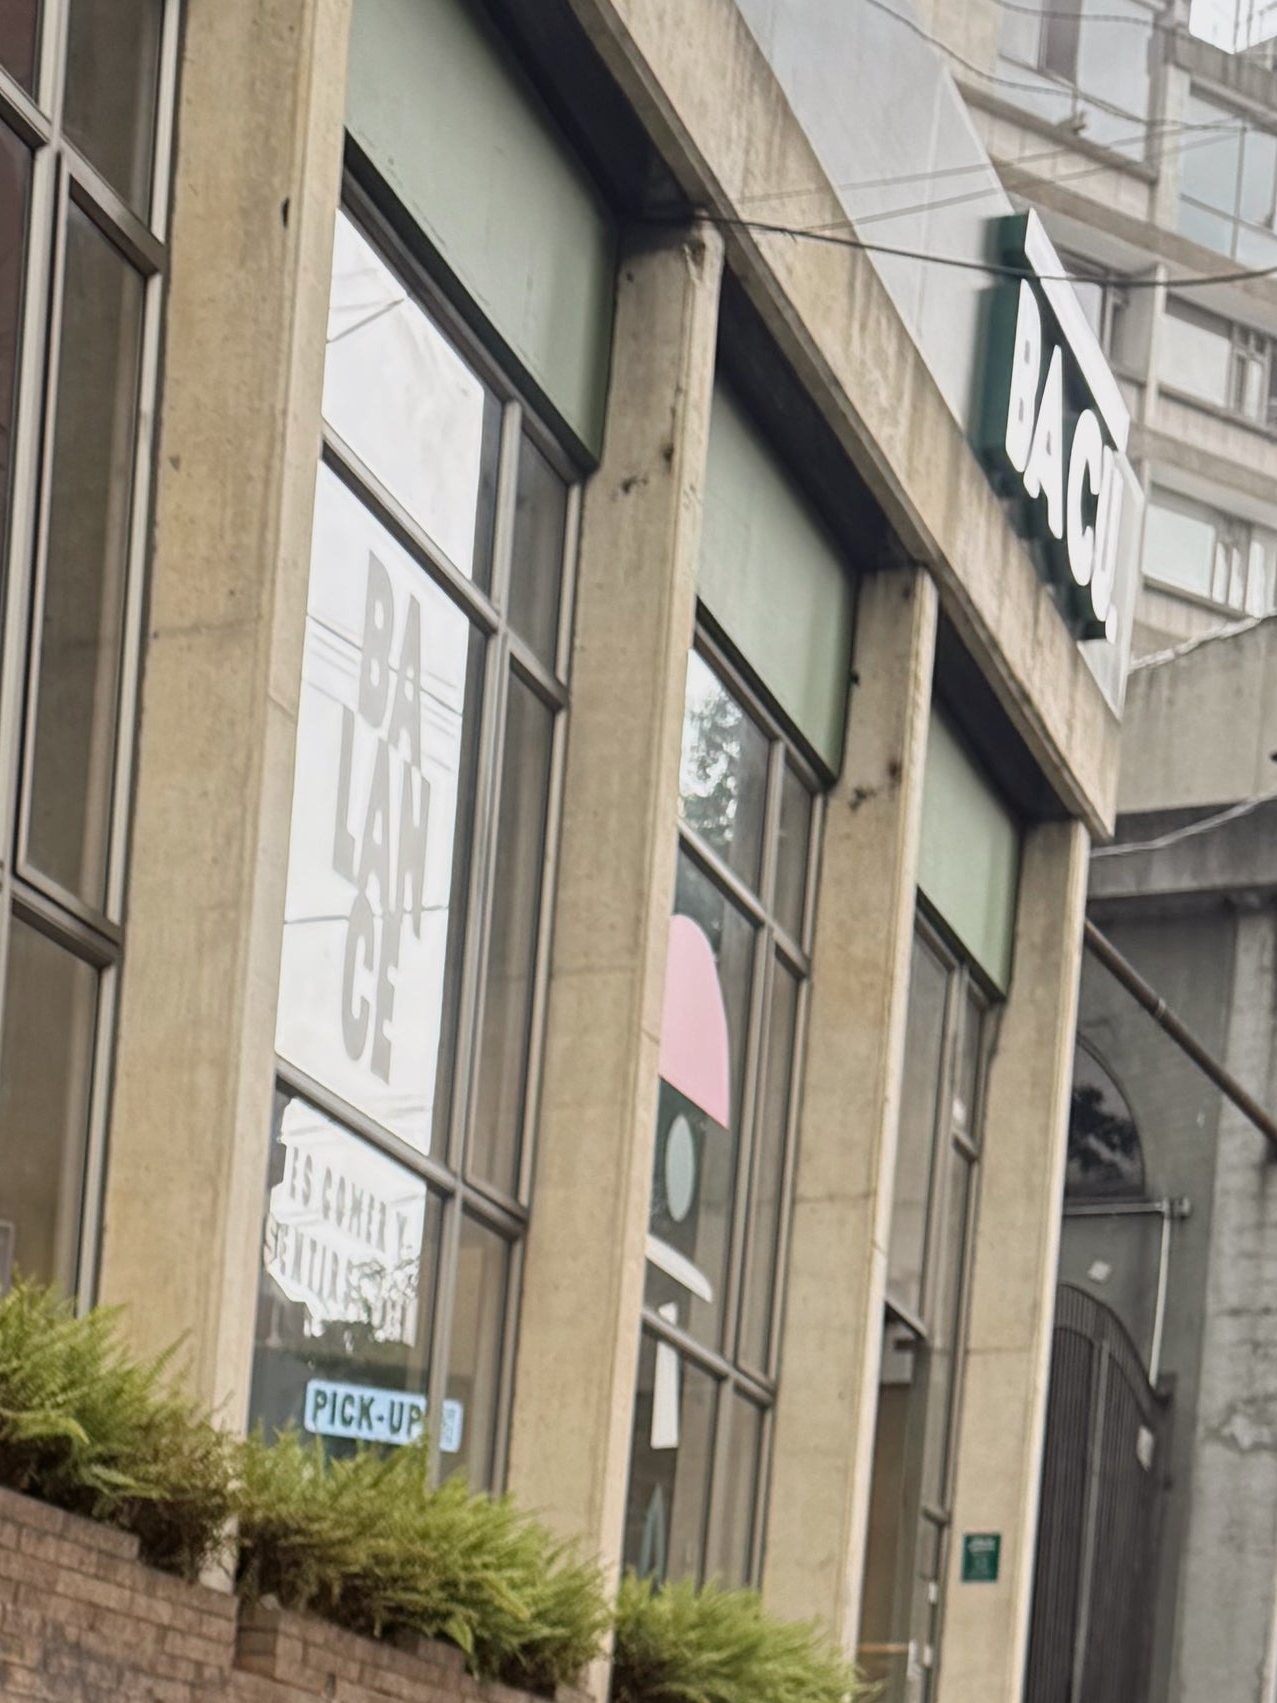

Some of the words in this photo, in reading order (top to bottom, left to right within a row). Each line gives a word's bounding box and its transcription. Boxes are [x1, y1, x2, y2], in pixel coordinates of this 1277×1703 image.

[289, 1145, 313, 1208] ES
[321, 1166, 387, 1255] COMER
[312, 1389, 424, 1438] PICK-UP
